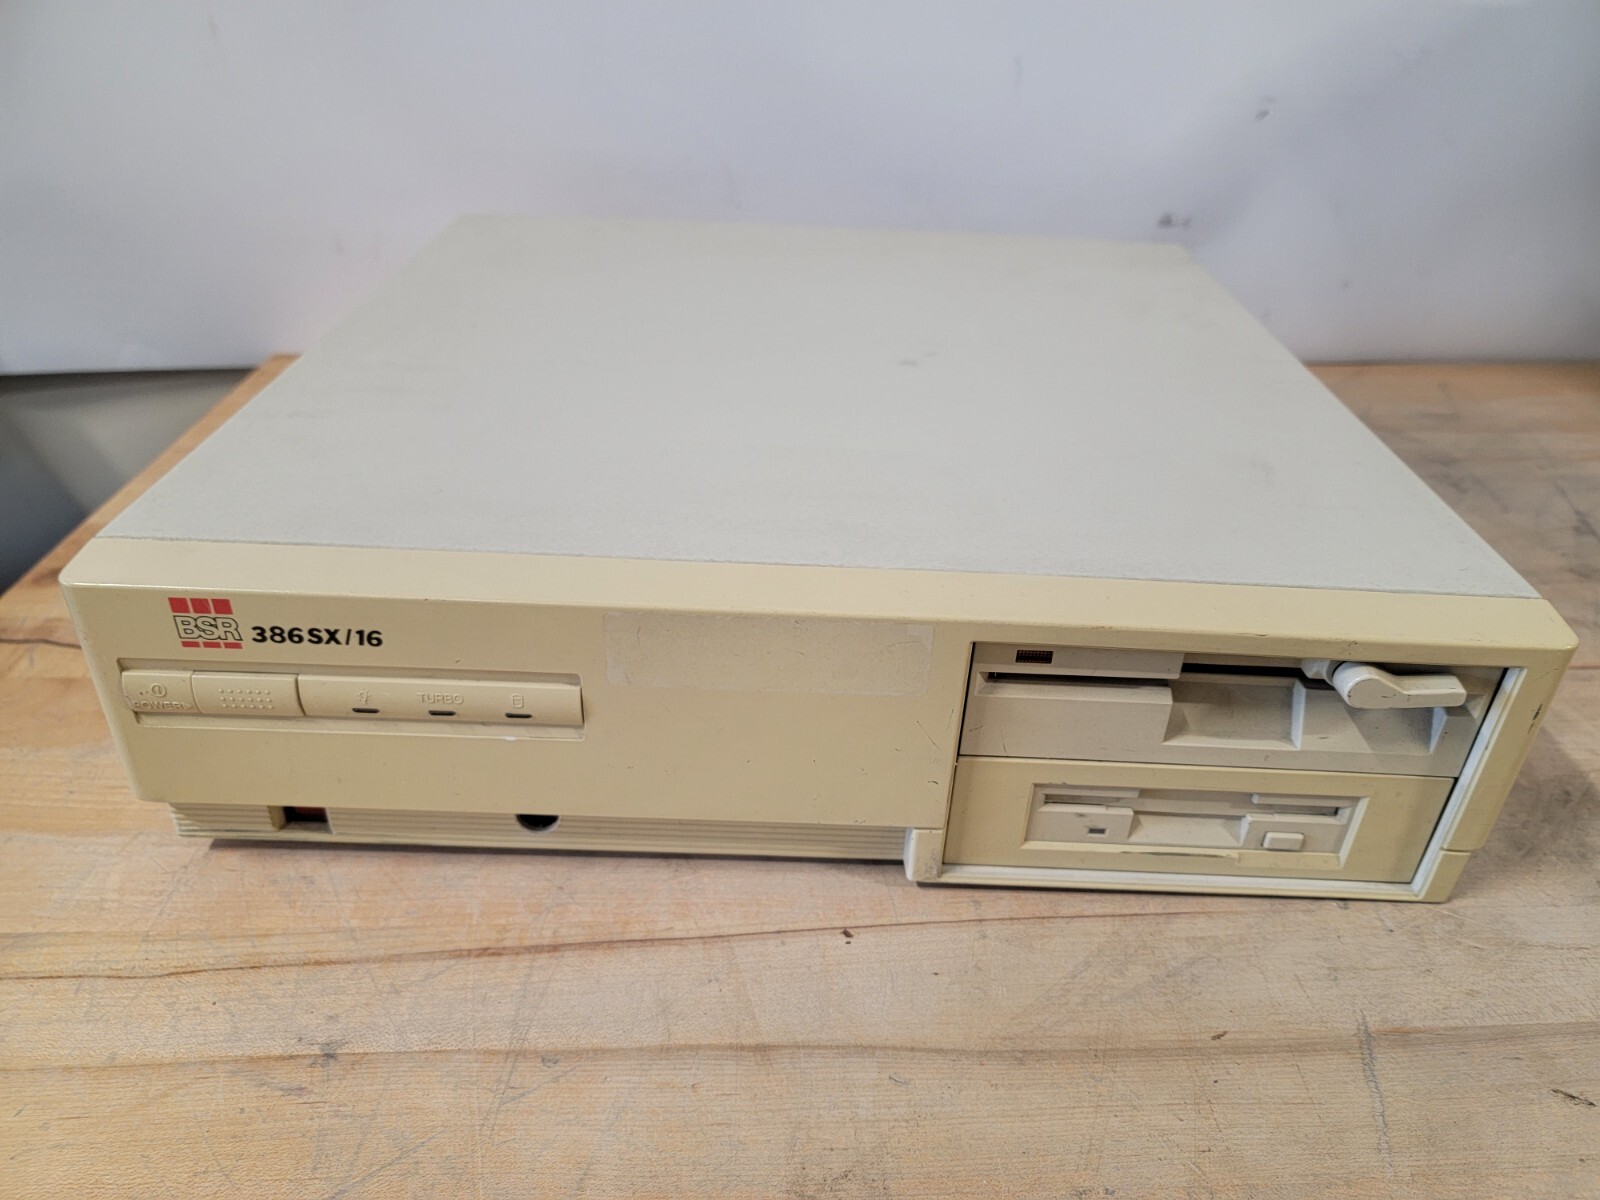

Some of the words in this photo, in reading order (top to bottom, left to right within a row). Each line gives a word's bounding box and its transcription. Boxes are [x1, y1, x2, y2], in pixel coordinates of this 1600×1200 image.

[173, 615, 243, 641] BSR
[132, 700, 181, 710] POWER
[417, 692, 464, 705] TURBO
